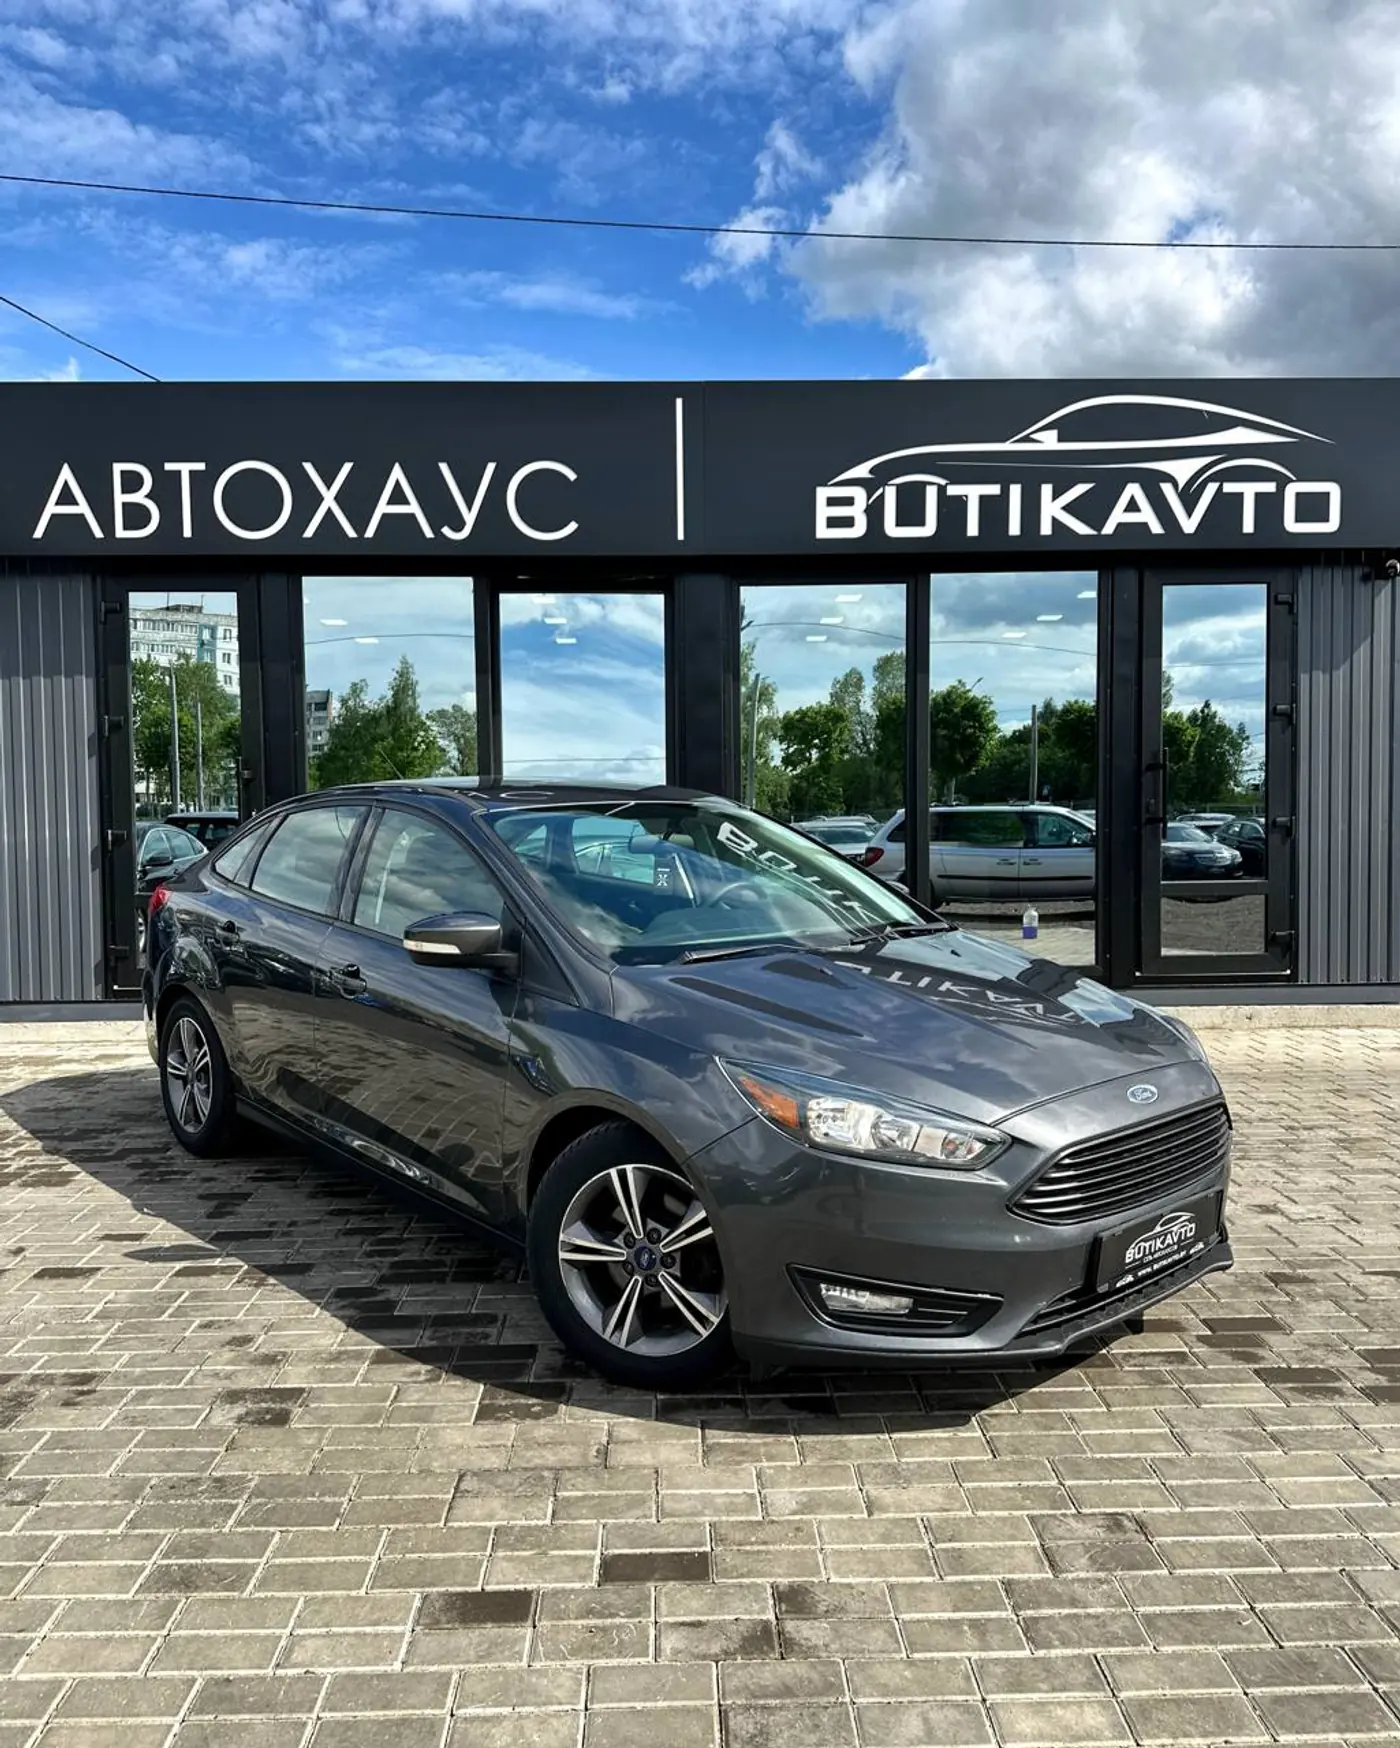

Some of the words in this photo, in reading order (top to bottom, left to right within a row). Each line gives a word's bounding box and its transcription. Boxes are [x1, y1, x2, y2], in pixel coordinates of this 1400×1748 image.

[32, 459, 579, 542] АВТОХАУС
[814, 480, 1342, 540] BUTIKAVTO
[1125, 1222, 1196, 1264] BUTIKAVTO
